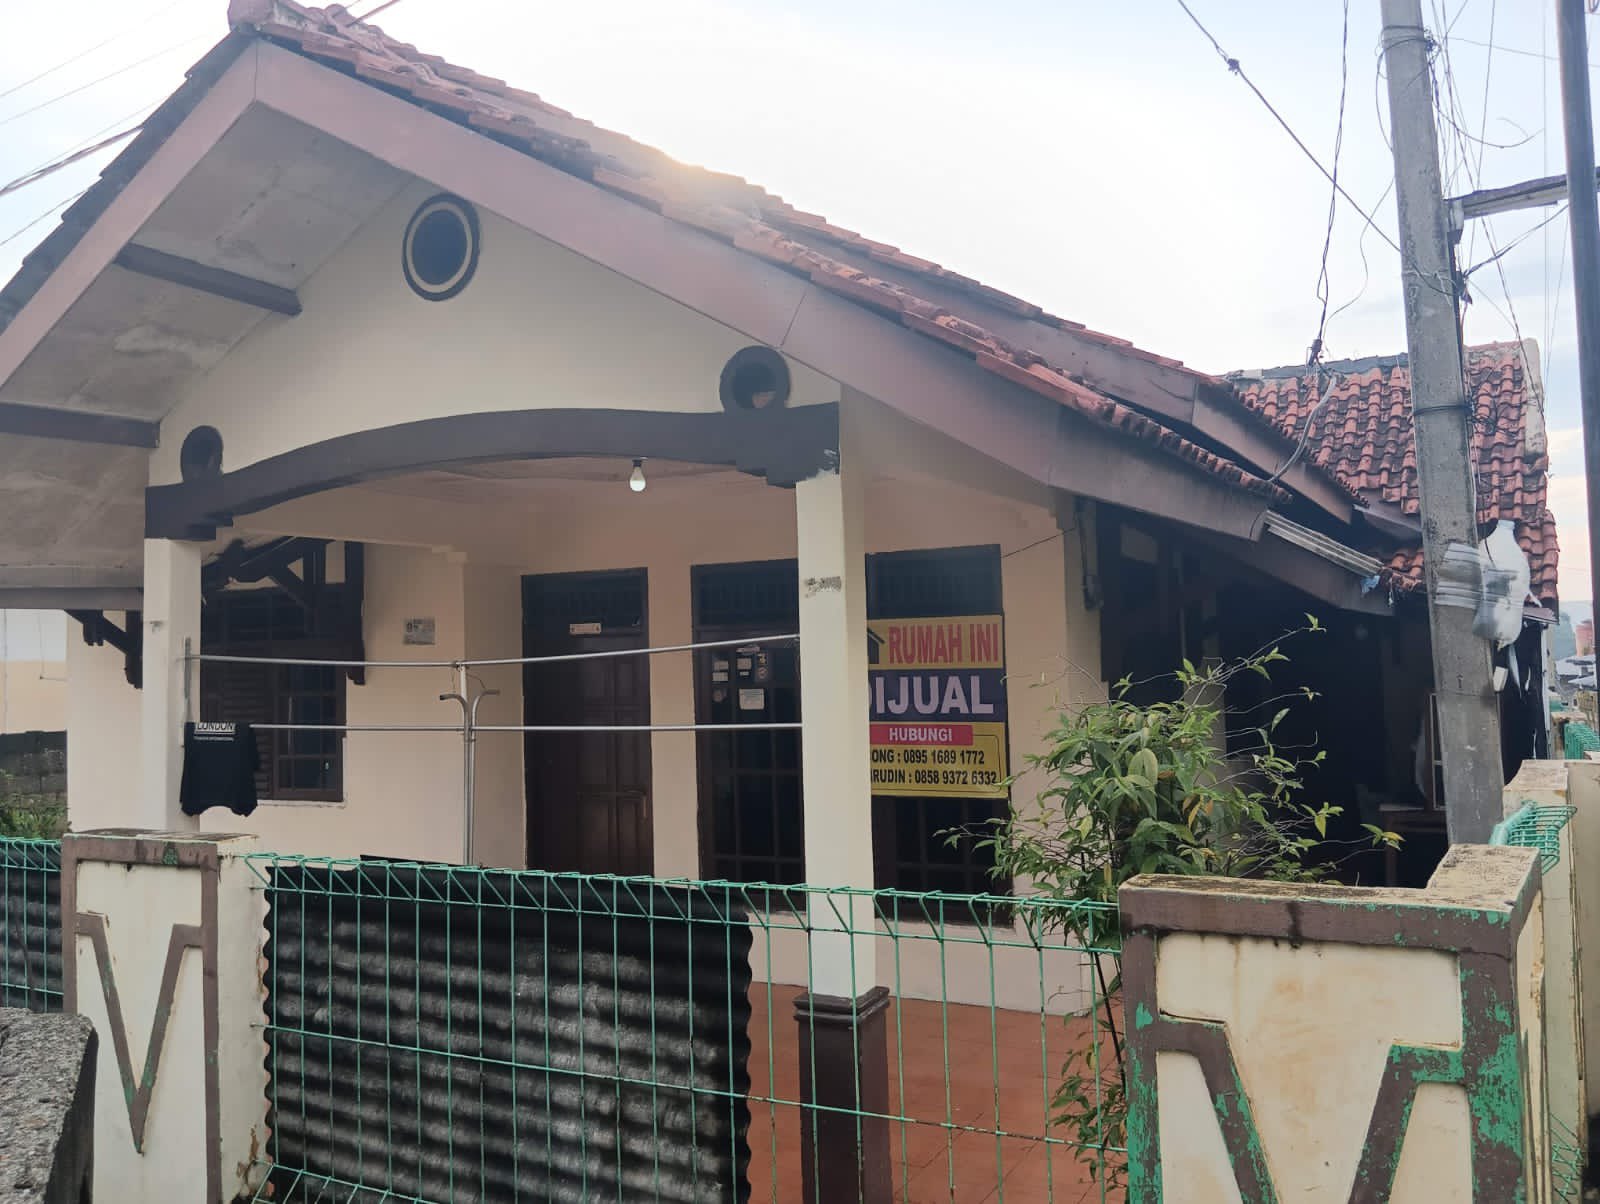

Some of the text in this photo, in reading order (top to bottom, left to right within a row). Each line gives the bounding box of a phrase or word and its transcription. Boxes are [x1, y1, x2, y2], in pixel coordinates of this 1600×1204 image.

[888, 623, 999, 664] RUMAH INI
[868, 675, 994, 715] IJUAL
[889, 727, 953, 742] HUBUNGI
[903, 750, 928, 764] 0895
[931, 750, 956, 764] 1689
[960, 750, 985, 765] 1772
[914, 770, 939, 784] 0858
[942, 770, 968, 785] 9372
[971, 771, 997, 785] 6332
